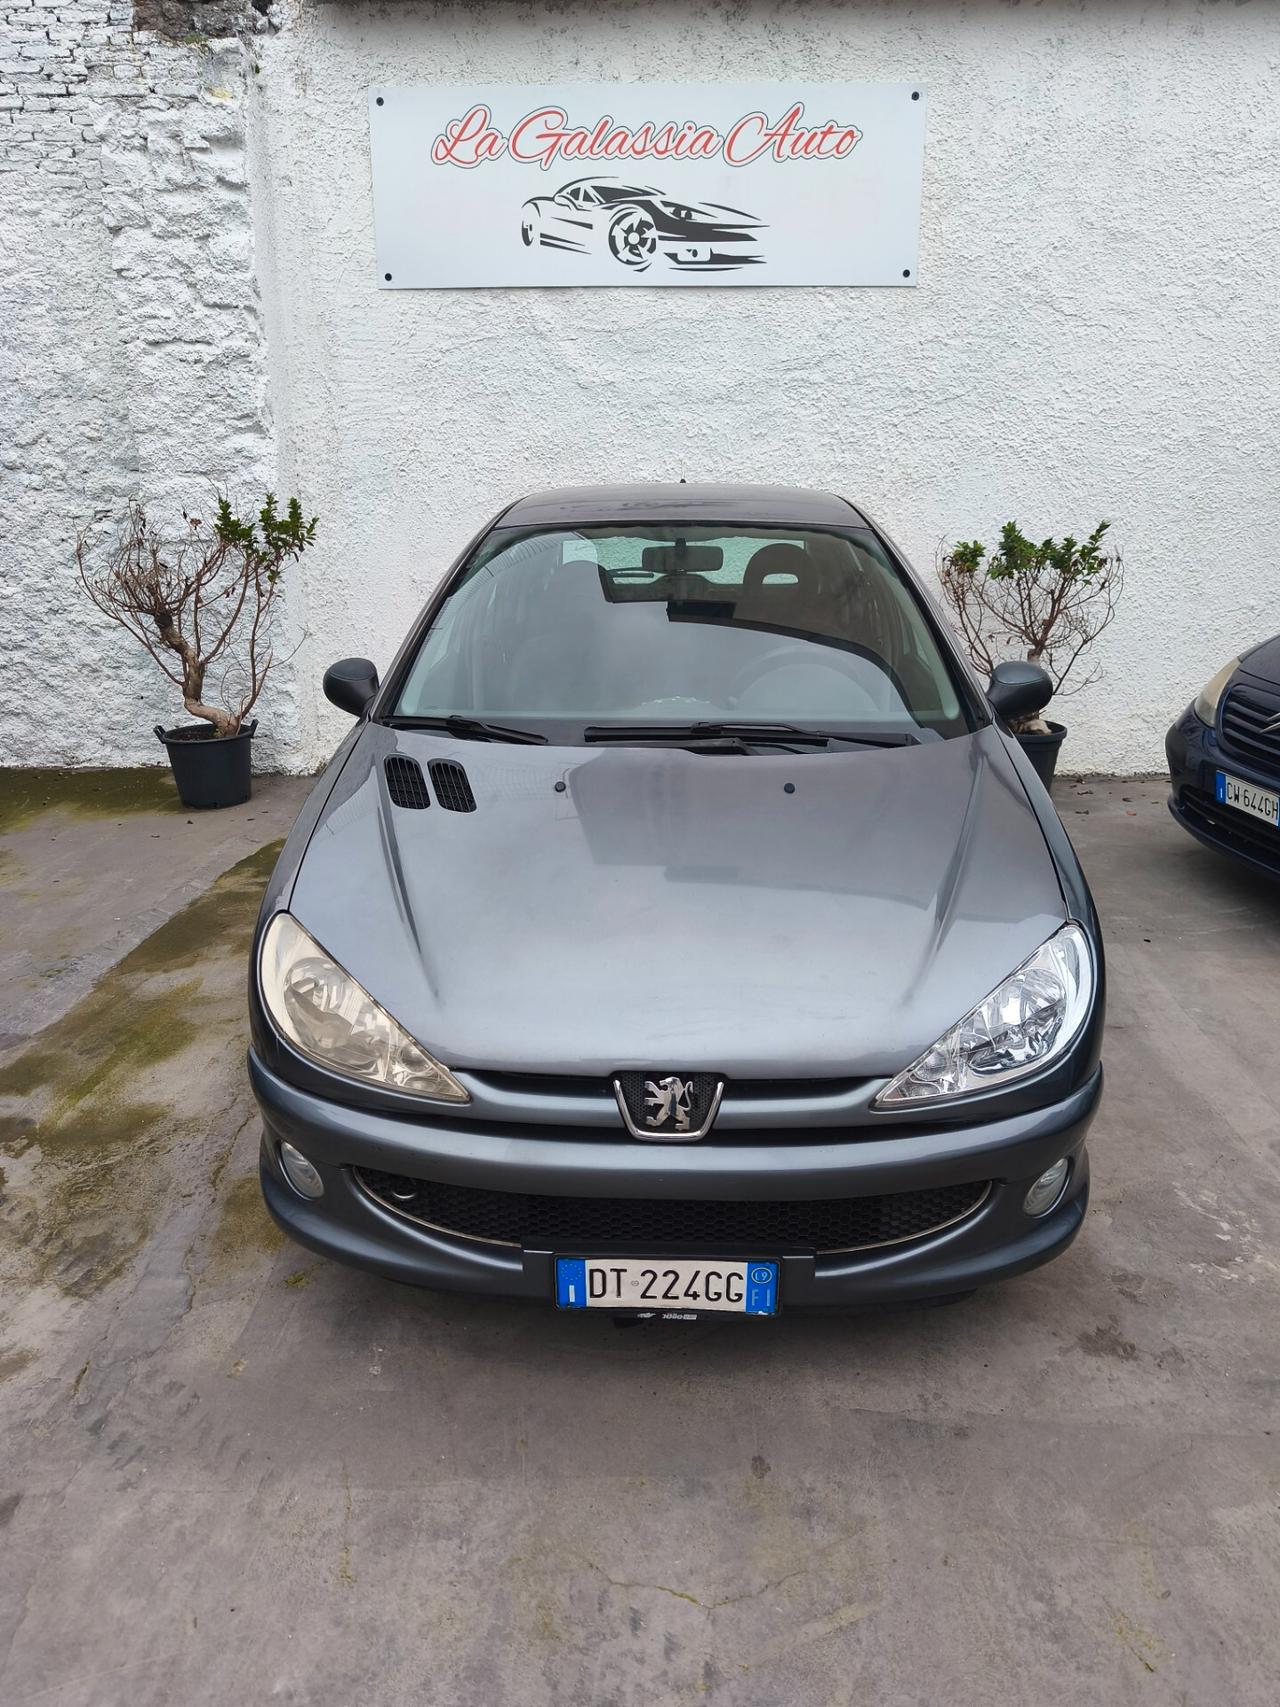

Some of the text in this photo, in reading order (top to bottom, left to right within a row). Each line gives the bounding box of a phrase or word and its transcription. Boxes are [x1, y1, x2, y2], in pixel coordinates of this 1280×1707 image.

[431, 102, 863, 170] La Galassia Auto
[1227, 782, 1279, 820] CW 644GH
[589, 1268, 744, 1302] DT 224GG
[751, 1289, 770, 1307] FI
